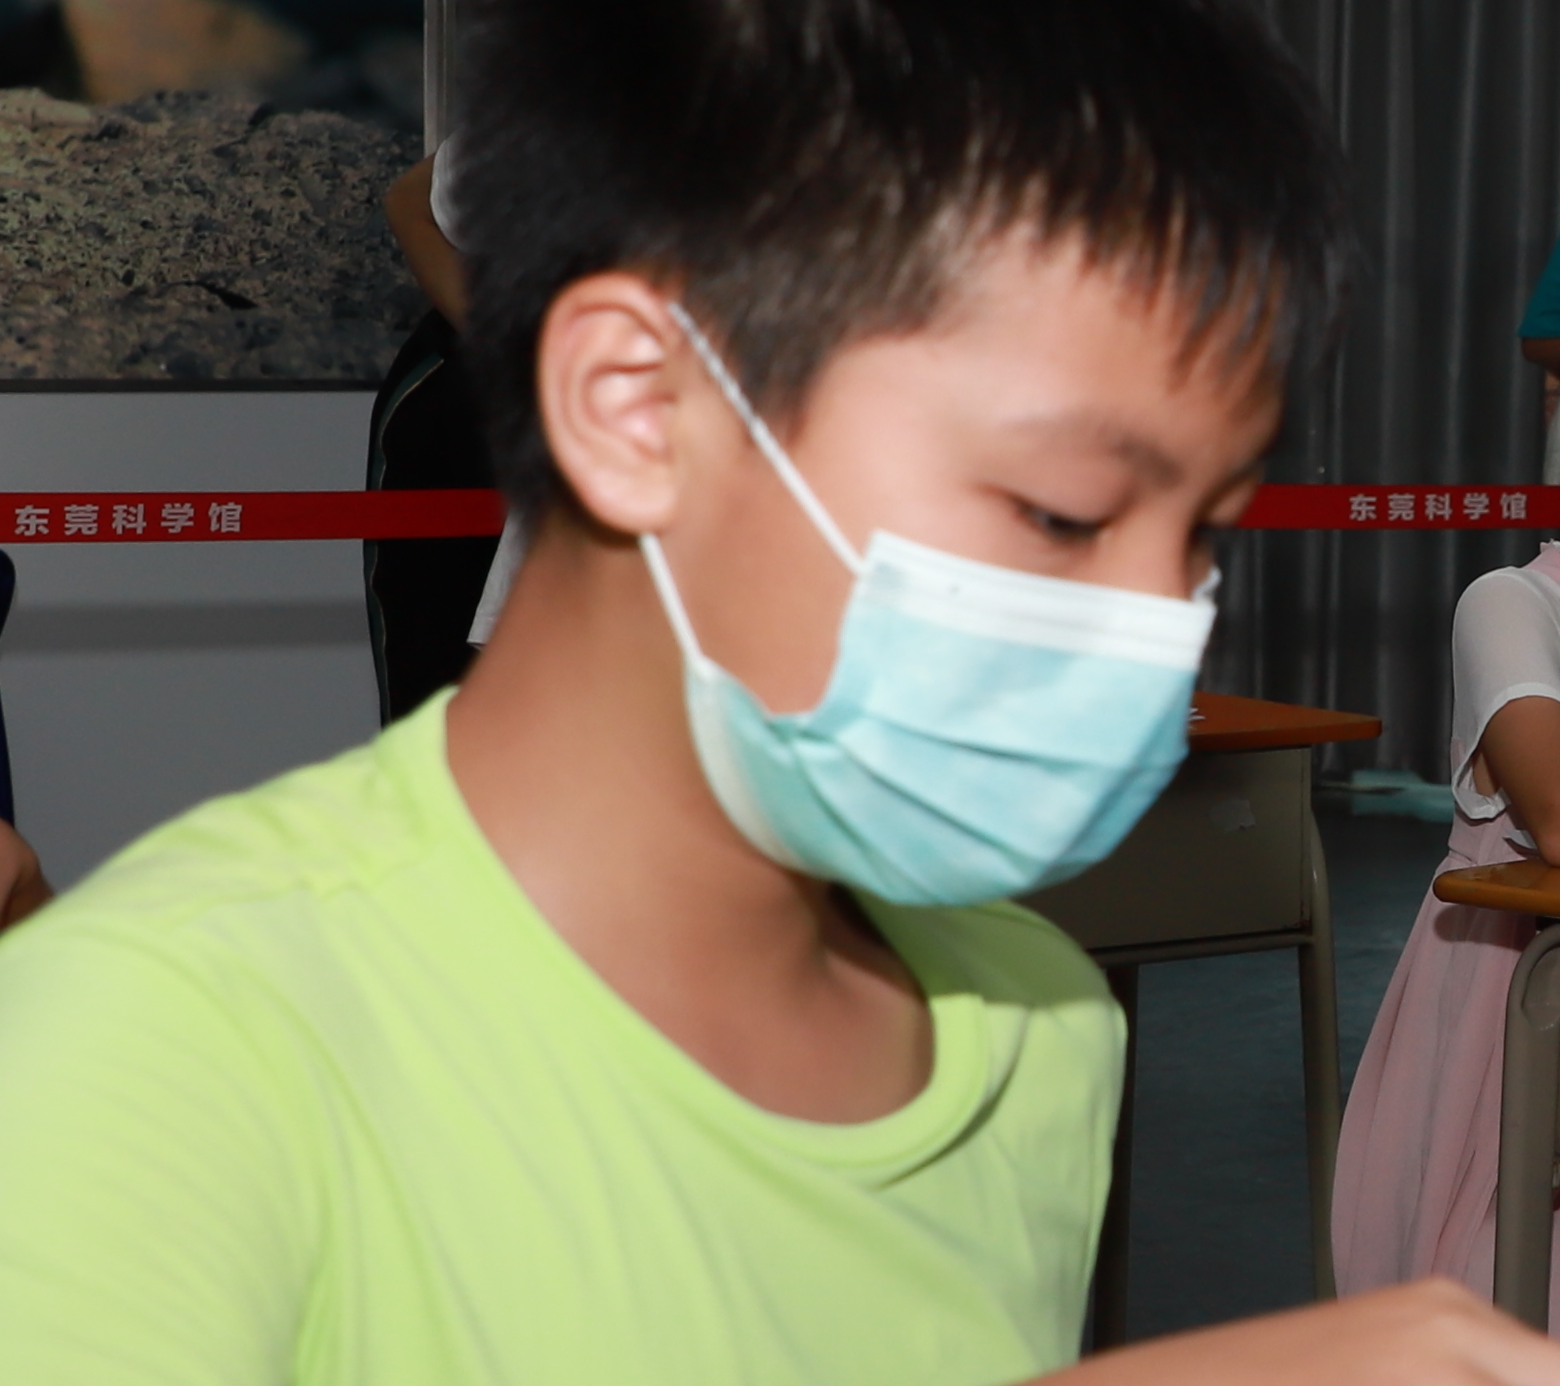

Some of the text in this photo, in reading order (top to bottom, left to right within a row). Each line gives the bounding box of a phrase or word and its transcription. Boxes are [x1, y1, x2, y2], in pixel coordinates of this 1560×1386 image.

[14, 502, 243, 536] 东莞科学馆
[1347, 491, 1529, 521] 东莞科学馆
